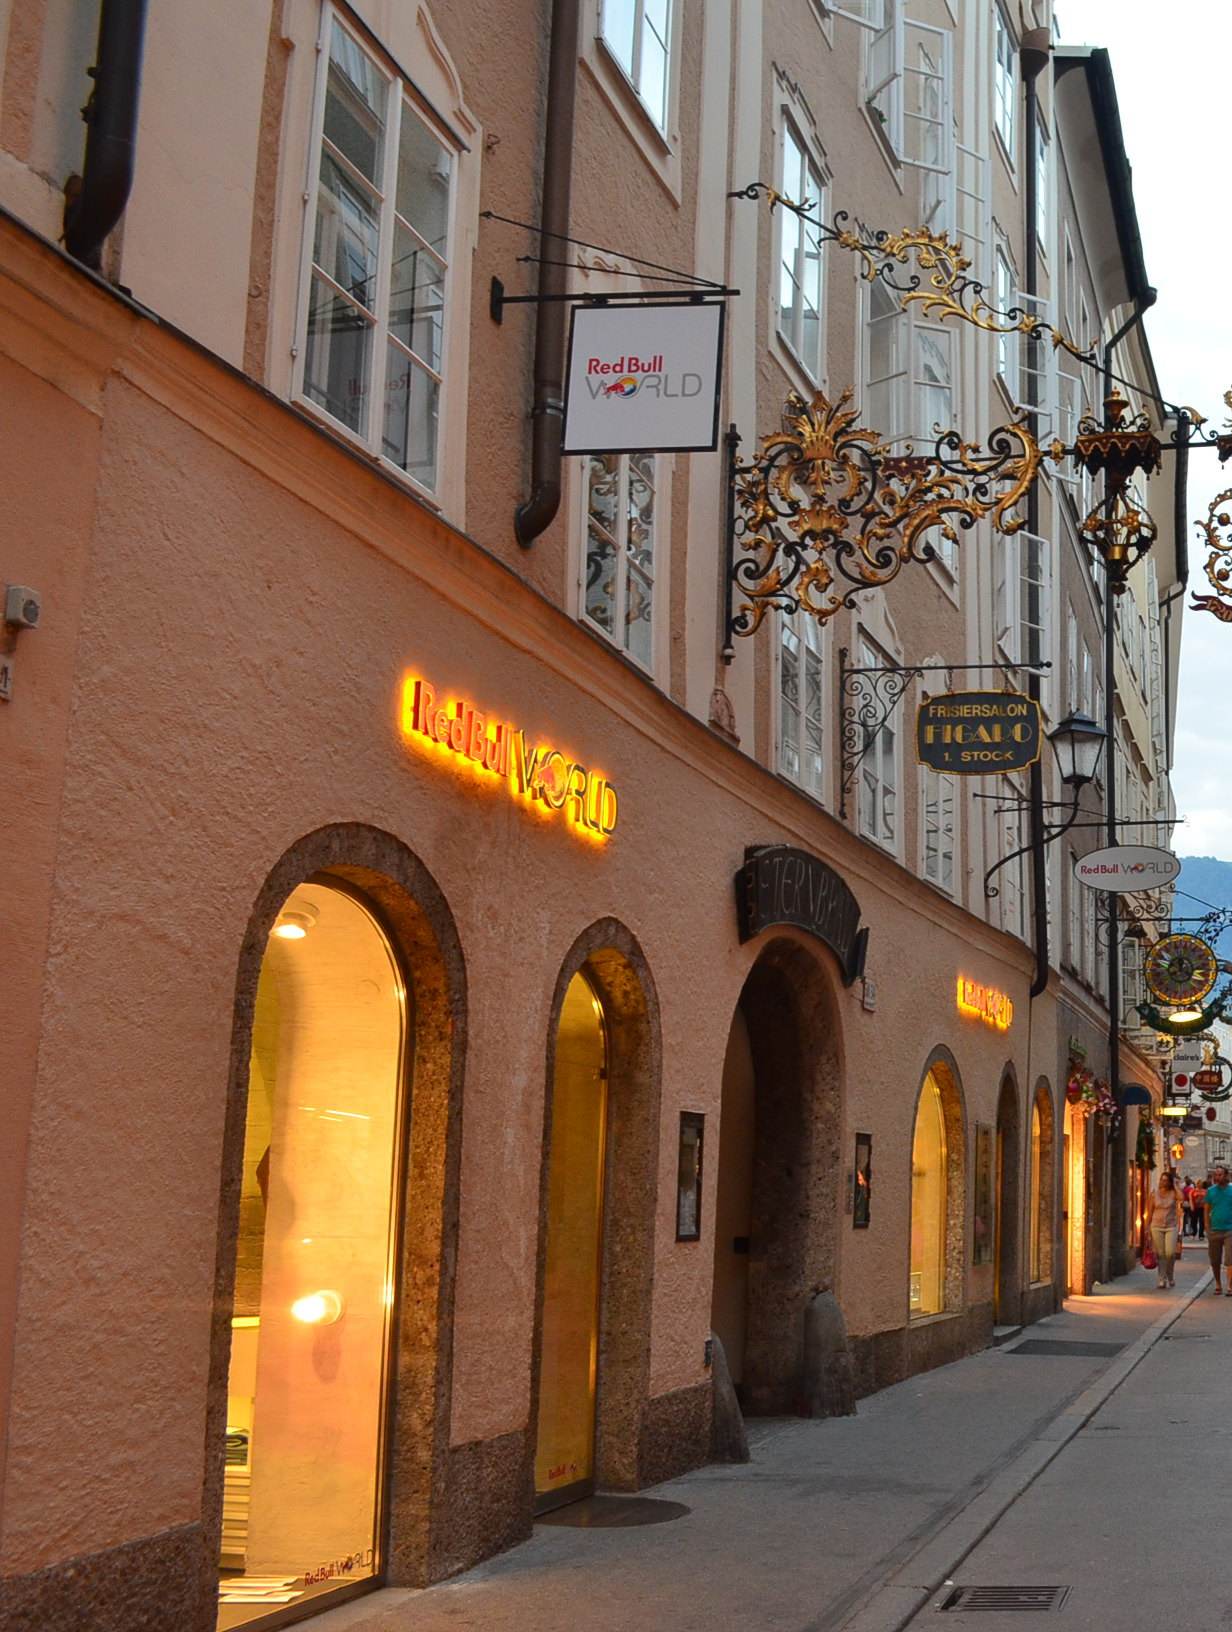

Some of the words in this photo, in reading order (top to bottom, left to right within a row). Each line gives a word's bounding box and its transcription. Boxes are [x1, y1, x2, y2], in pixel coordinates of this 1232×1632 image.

[587, 356, 624, 375] Red
[627, 355, 663, 373] Bull
[585, 372, 702, 400] WORLD
[928, 703, 1028, 718] FRISIERSALON
[412, 680, 467, 753] Red
[467, 710, 514, 777] Bull
[924, 723, 1032, 744] FIGARO
[960, 751, 1015, 762] STOCK
[1080, 865, 1099, 875] Red
[1100, 863, 1119, 874] Bull
[304, 1567, 319, 1587] Red
[320, 1562, 334, 1581] Bull
